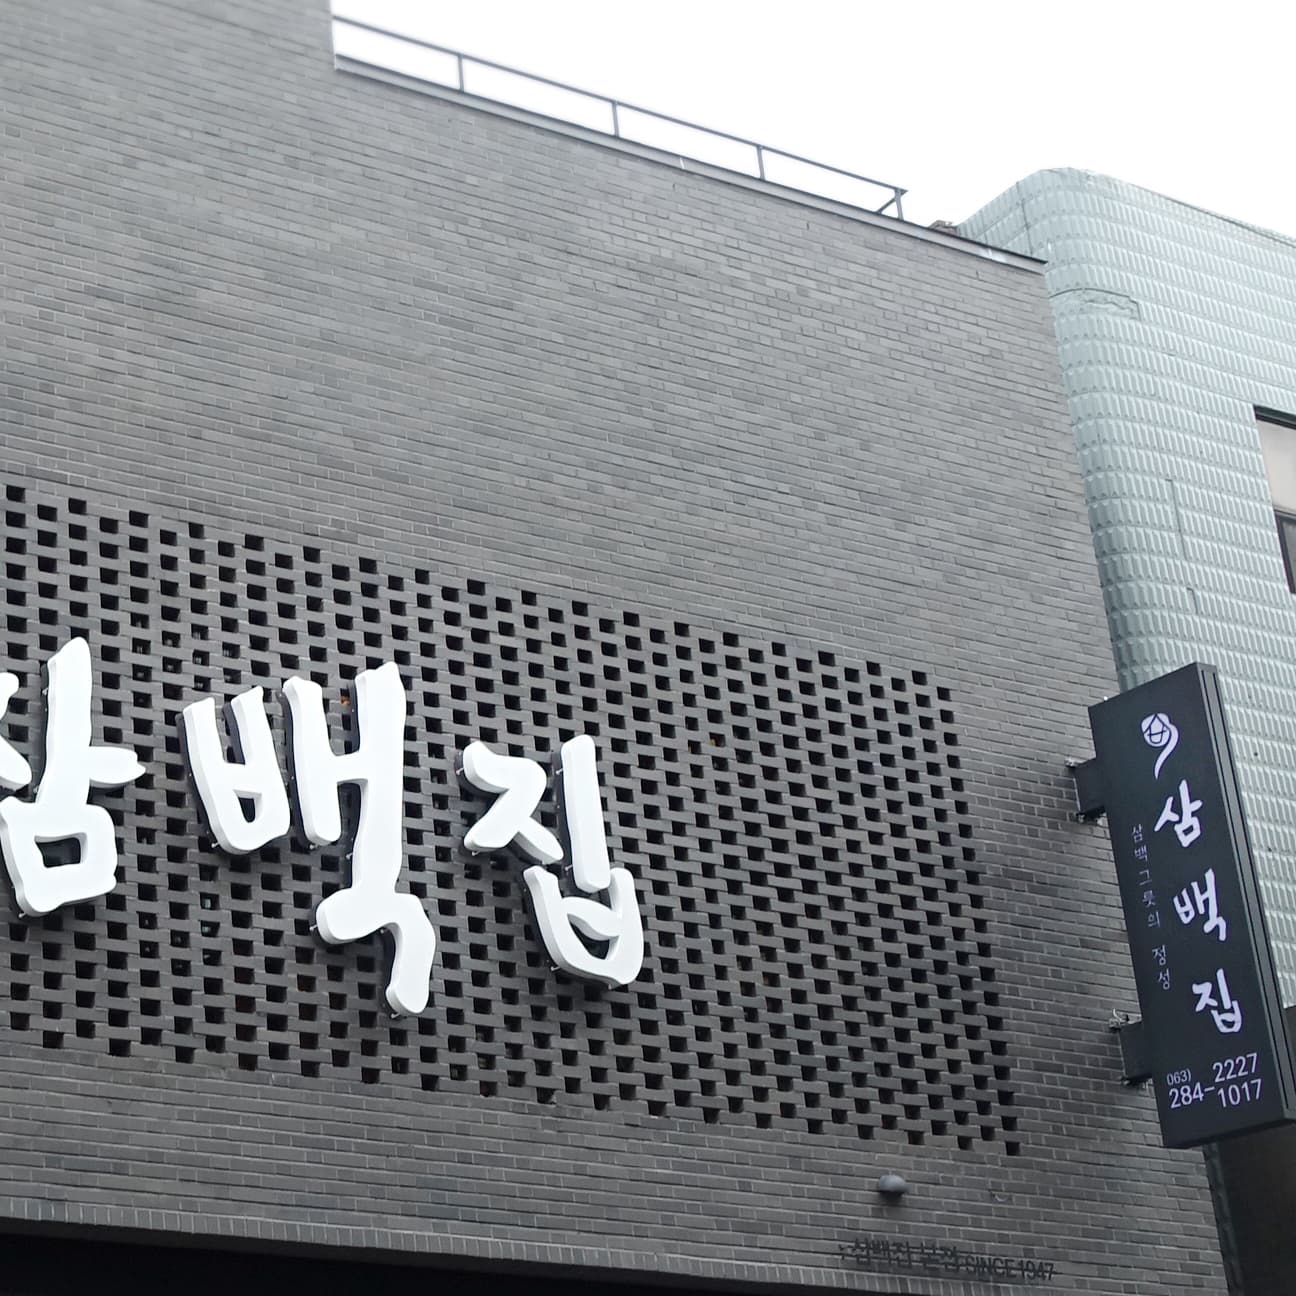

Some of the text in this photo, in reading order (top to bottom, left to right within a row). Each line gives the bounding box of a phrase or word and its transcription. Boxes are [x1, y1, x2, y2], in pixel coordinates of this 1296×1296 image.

[1154, 779, 1242, 1033] 삼백집
[1151, 944, 1171, 991] 정성
[1212, 1052, 1258, 1083] 2227
